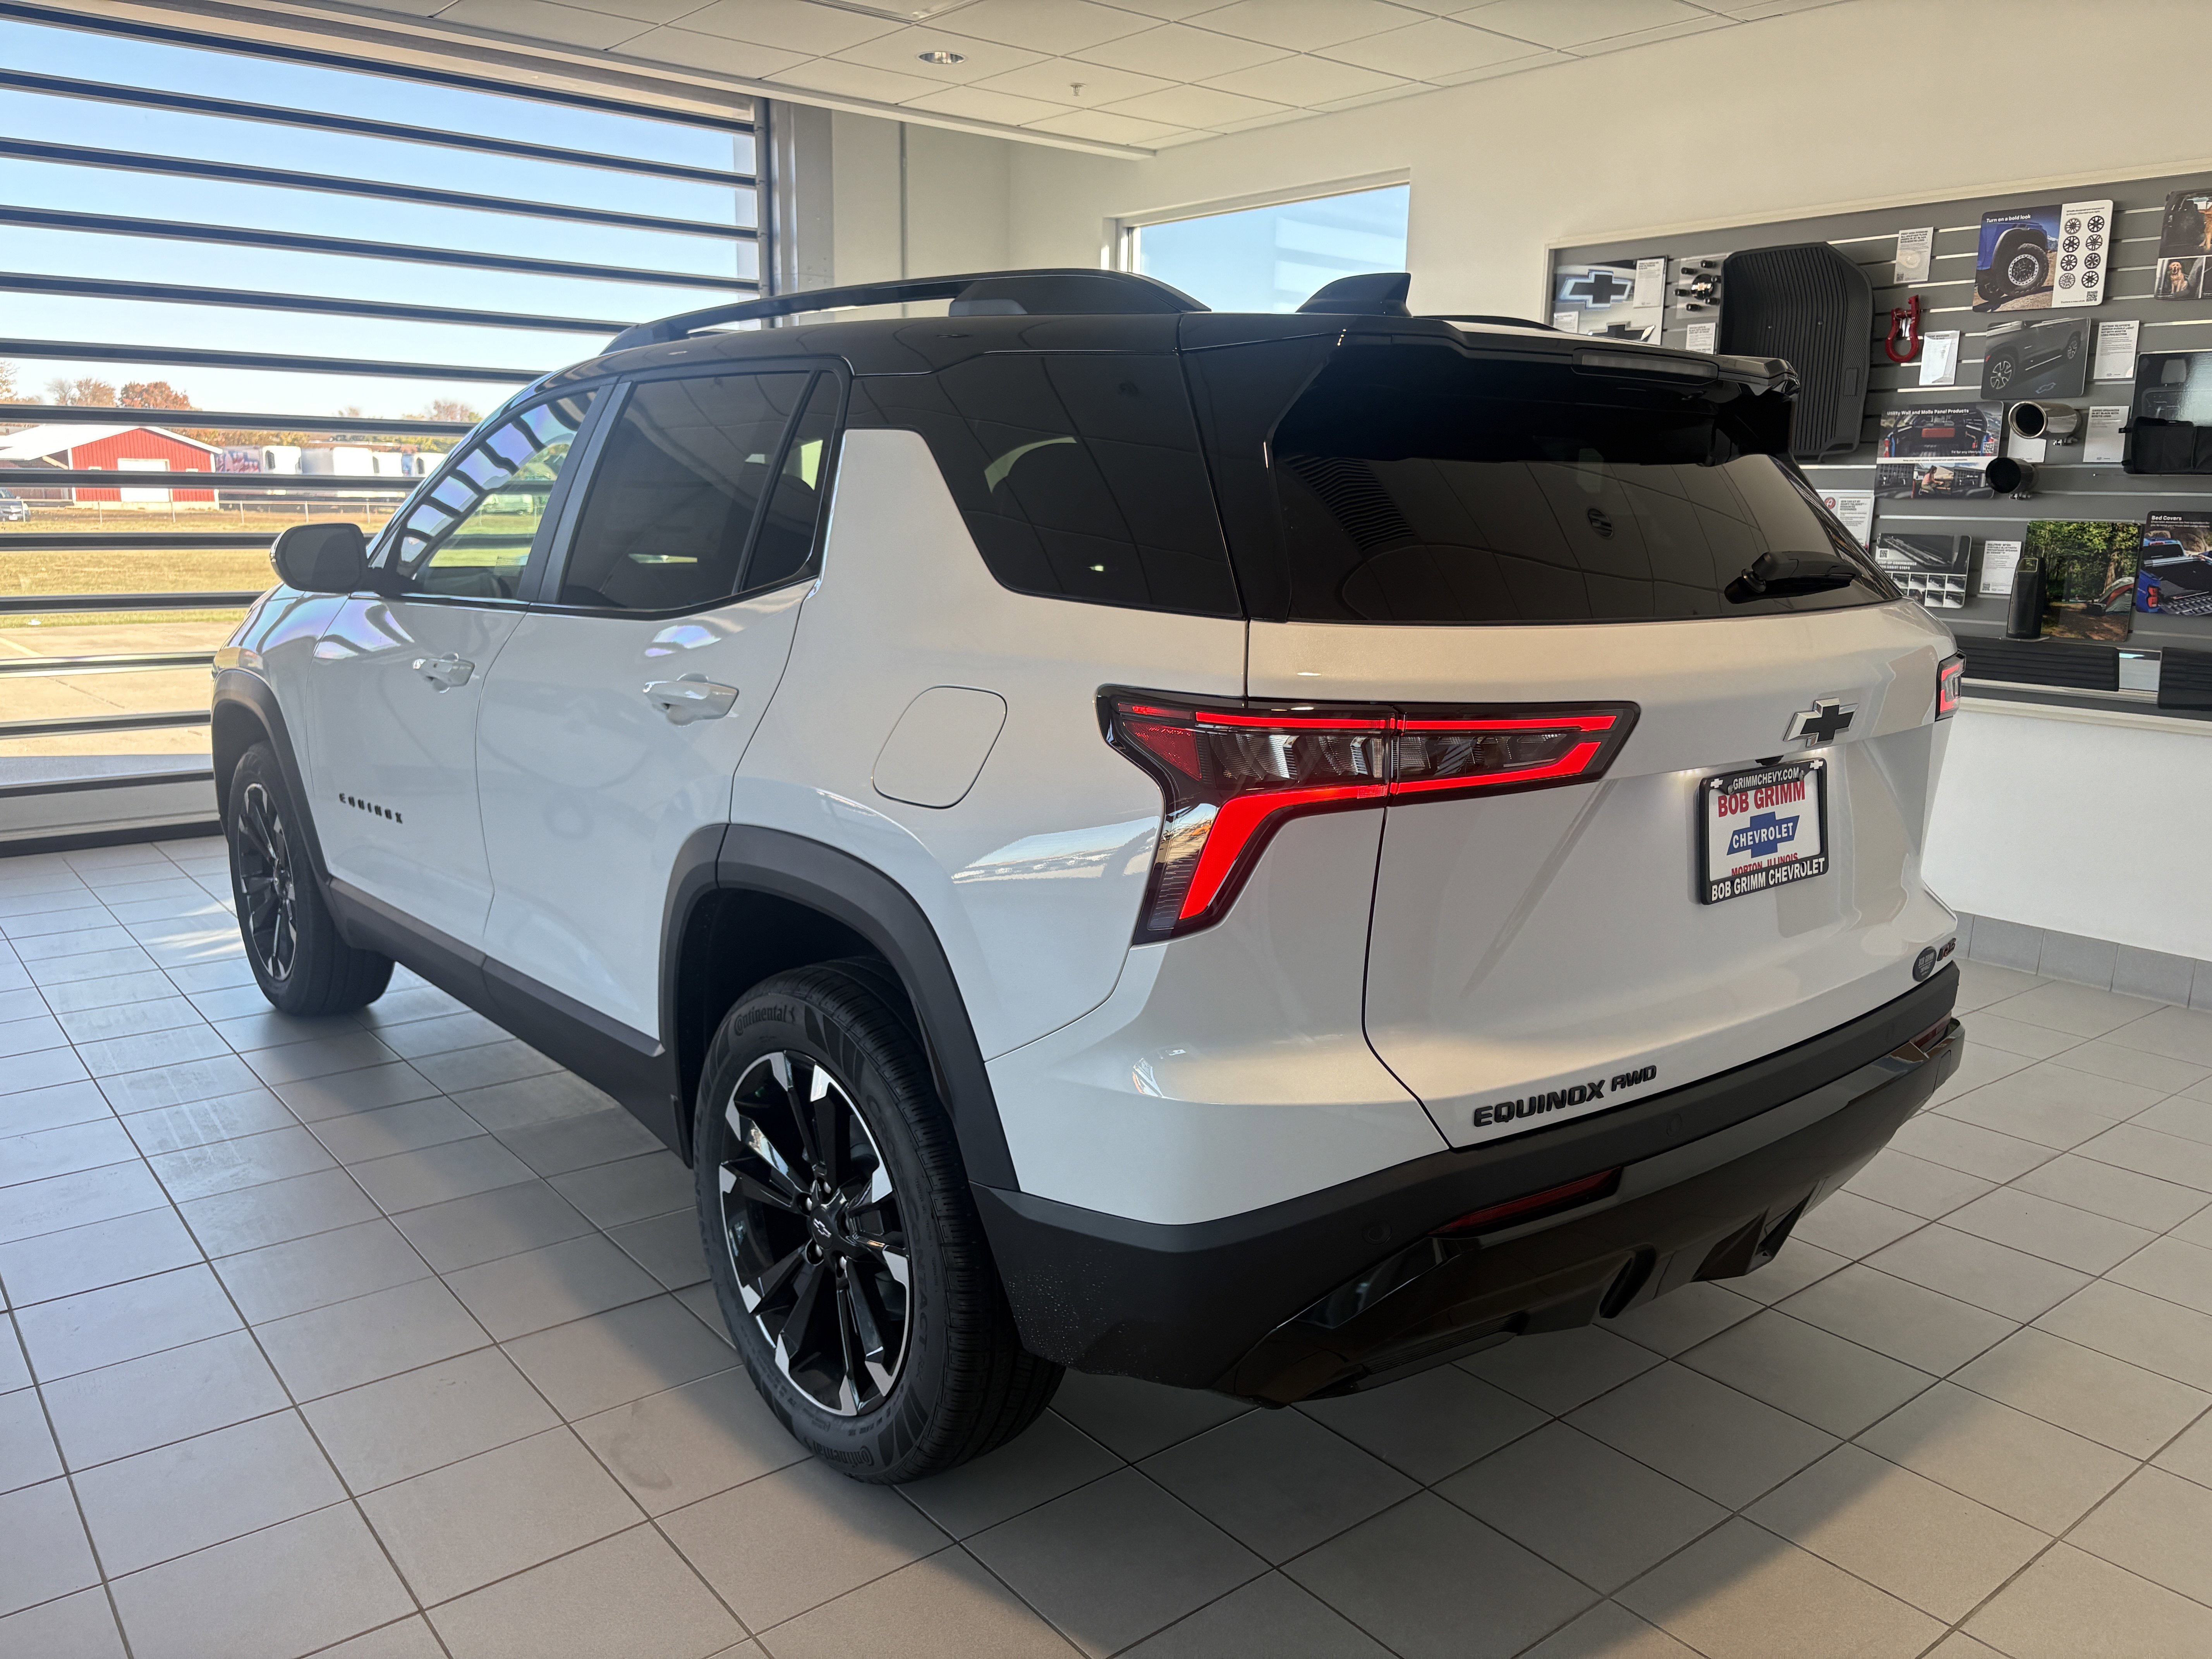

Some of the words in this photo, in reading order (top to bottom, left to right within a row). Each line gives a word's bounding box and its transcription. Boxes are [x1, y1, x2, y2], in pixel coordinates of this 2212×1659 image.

[1733, 767, 1799, 790] GRIMMCHEVY.COM
[339, 793, 403, 824] EQUINOX
[1718, 791, 1749, 817] BOB
[1754, 781, 1805, 809] GRIMM
[1733, 822, 1793, 849] CHEVROLET
[1712, 881, 1731, 902] BOB
[1734, 872, 1766, 895] GRIMM
[1769, 857, 1825, 885] CHEVROLET
[734, 1003, 787, 1036] Continental
[1474, 1079, 1605, 1127] EQUINOX
[1611, 1065, 1657, 1092] AWD
[812, 1441, 875, 1468] Continental
